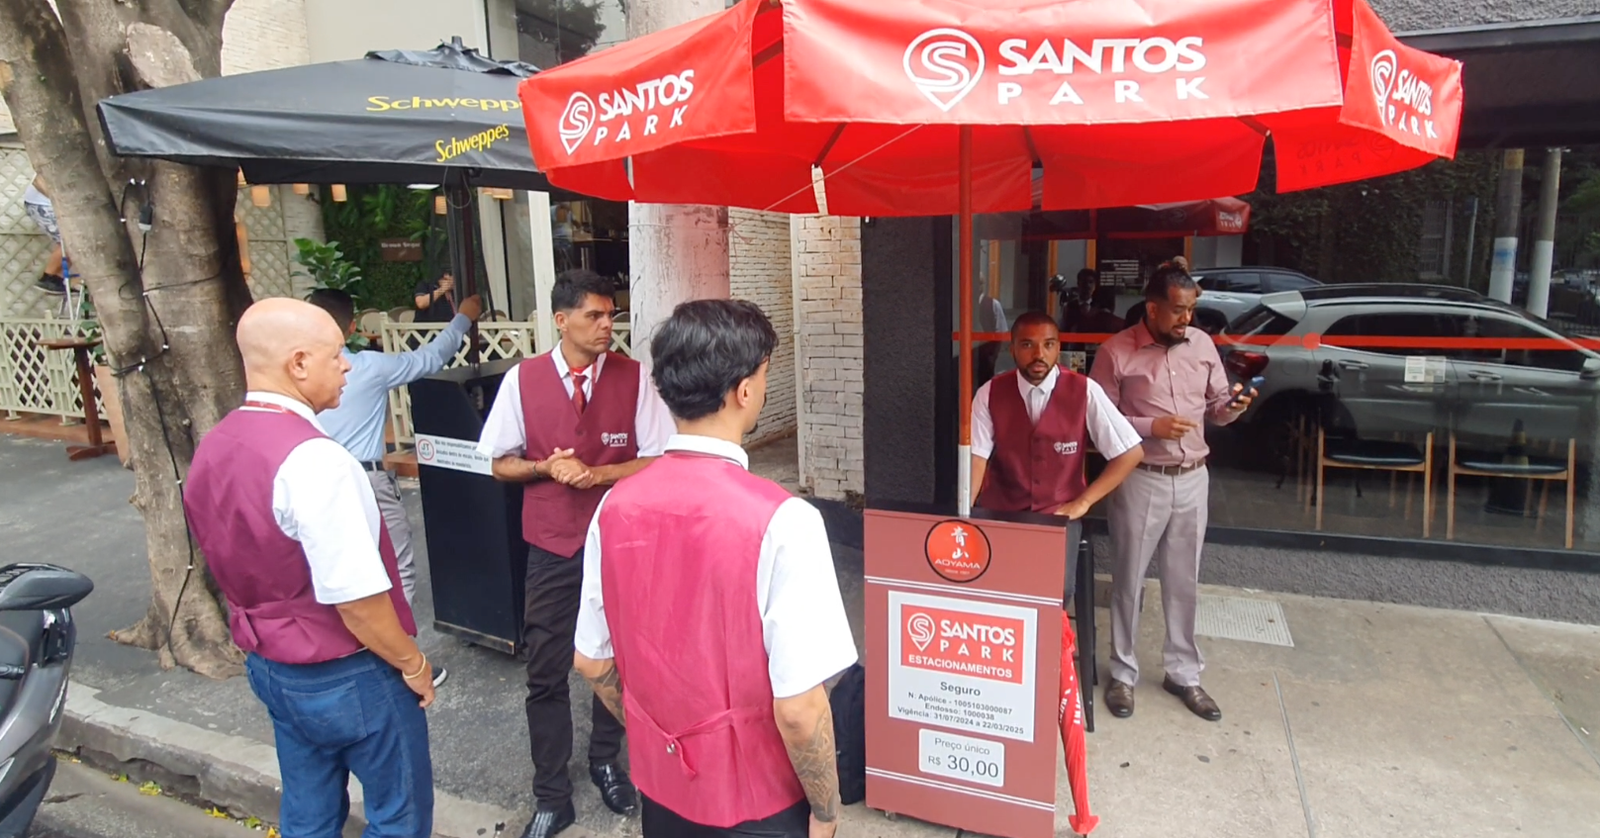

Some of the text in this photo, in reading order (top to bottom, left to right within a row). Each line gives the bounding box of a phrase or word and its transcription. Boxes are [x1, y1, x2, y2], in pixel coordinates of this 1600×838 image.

[998, 36, 1206, 75] SANTOS
[366, 96, 522, 111] Schwepp
[599, 69, 694, 121] SANTOS
[997, 77, 1209, 105] PARK
[1392, 69, 1433, 116] SANTOS
[594, 105, 688, 146] PARK
[1388, 104, 1438, 139] PARK
[435, 123, 510, 162] Schweppes
[935, 558, 981, 569] AOYAMA
[940, 619, 1015, 646] SANTOS
[940, 639, 1014, 663] PARK
[908, 654, 1013, 679] ESTACIONAMENTOS
[918, 693, 947, 704] Apólice
[940, 681, 981, 697] Seguro
[897, 706, 932, 718] Vigência:
[933, 712, 974, 726] 31/07/2024
[982, 720, 1024, 735] 22/03/2025
[925, 702, 961, 715] Endosso:
[934, 737, 990, 756] Preço único
[928, 754, 999, 778] R$ 30,00
